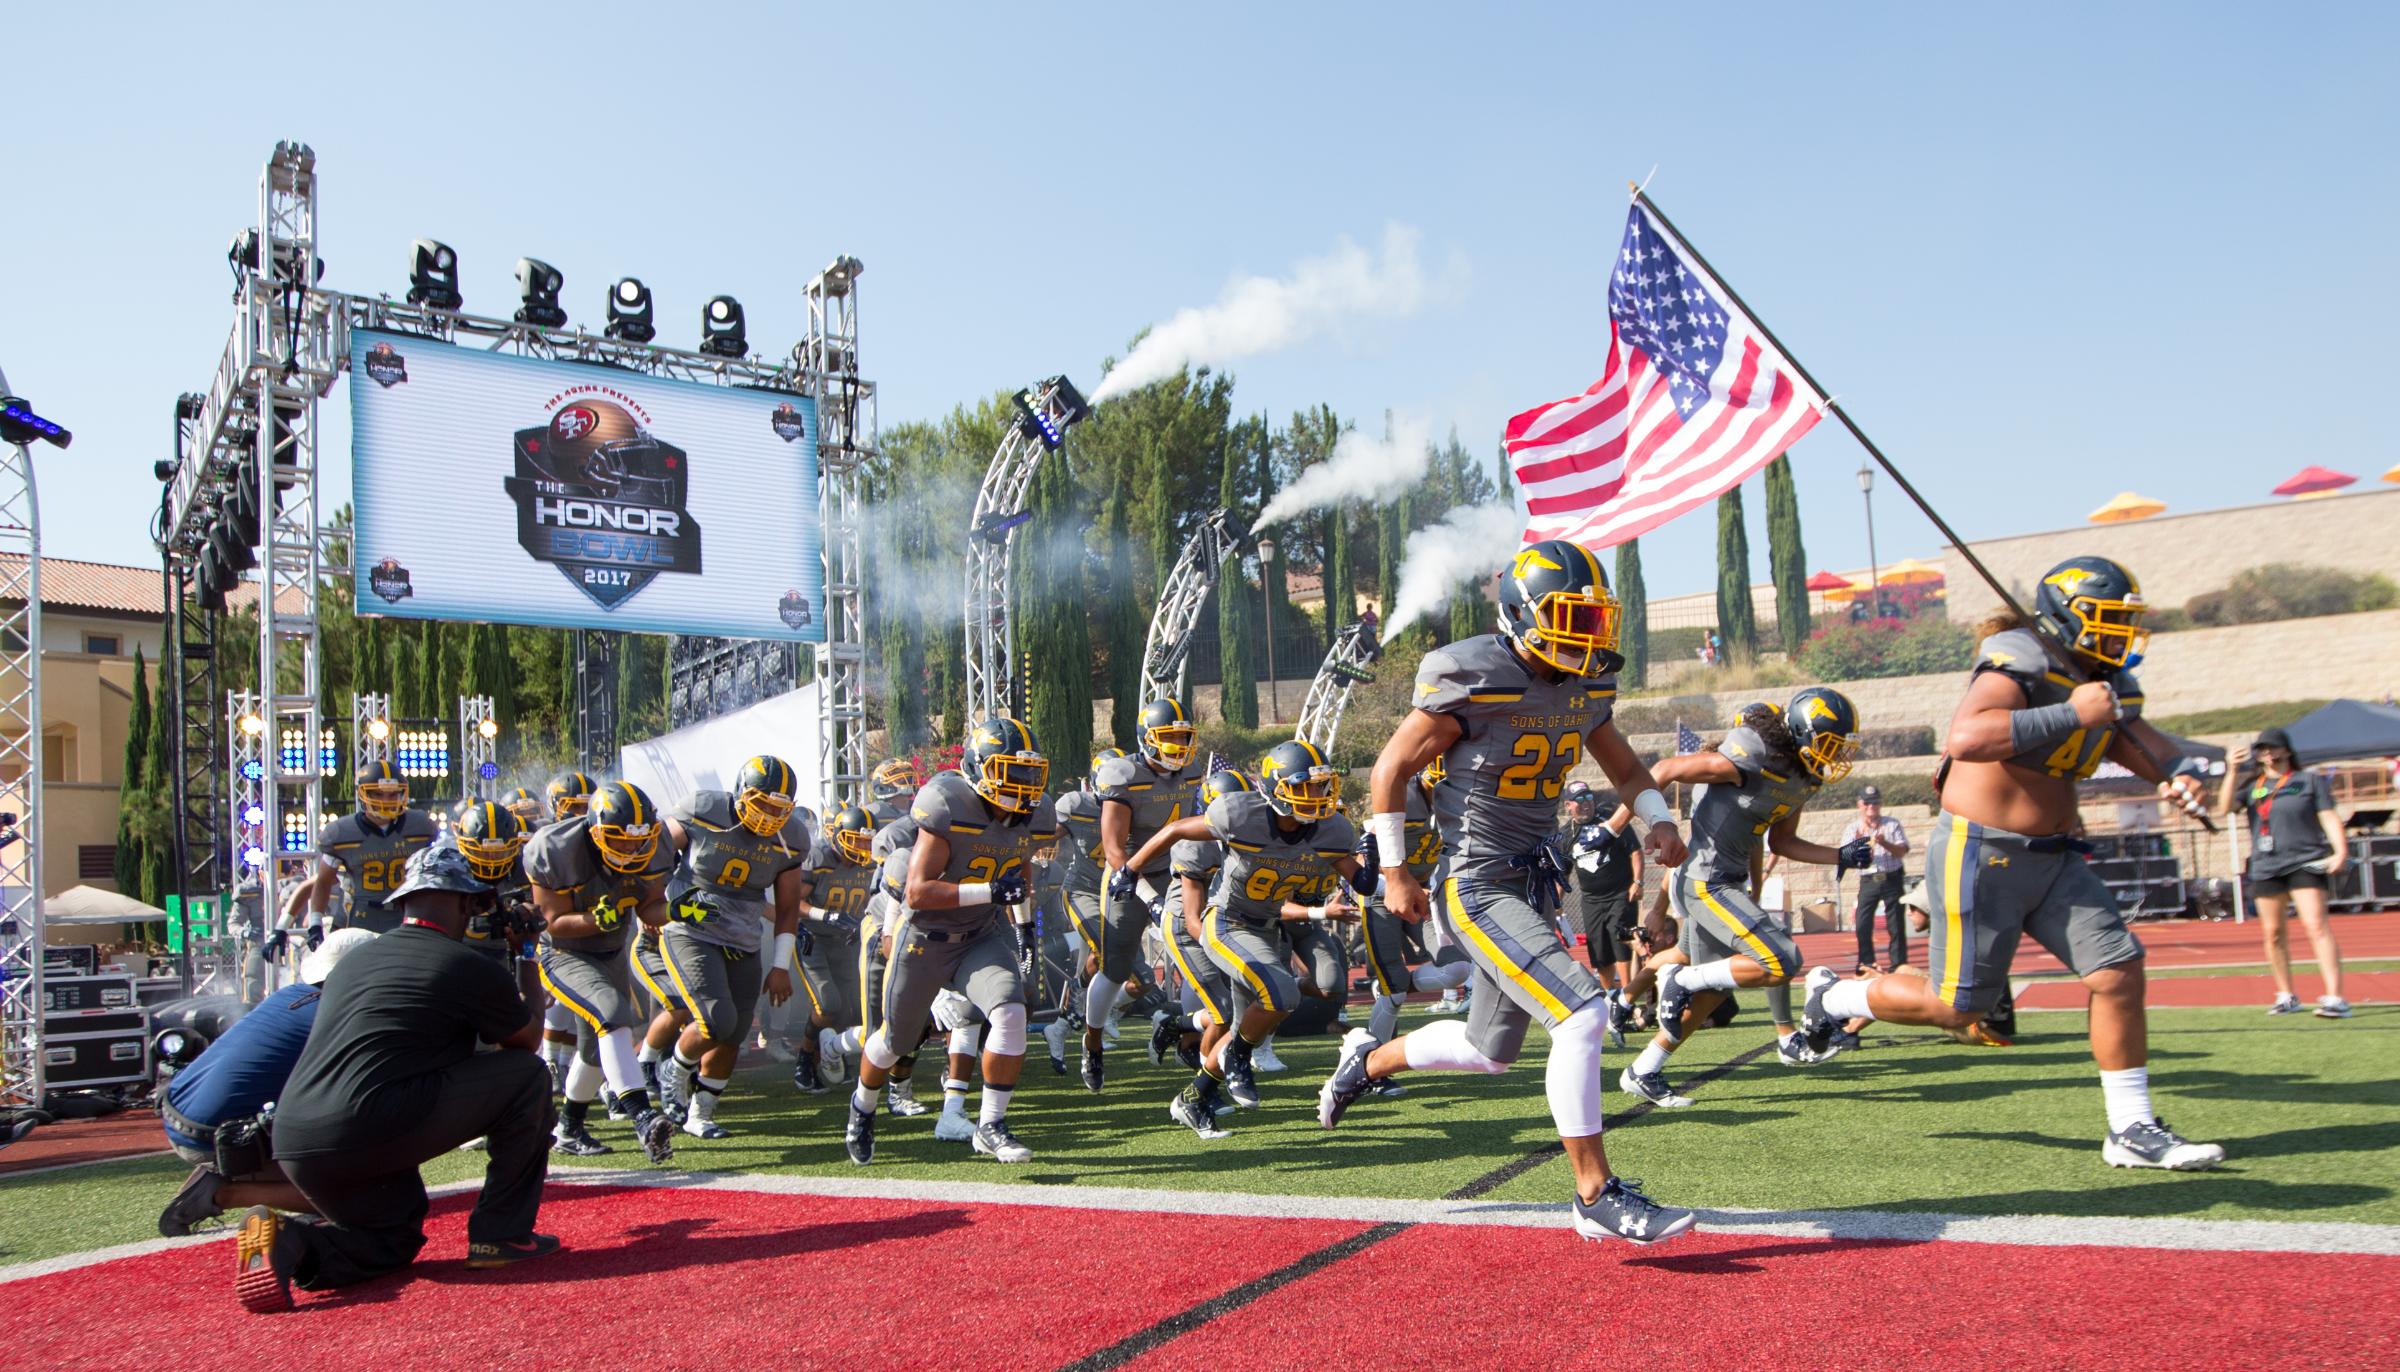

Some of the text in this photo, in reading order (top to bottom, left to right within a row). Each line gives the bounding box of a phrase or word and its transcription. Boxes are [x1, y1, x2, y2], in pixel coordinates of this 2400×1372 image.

[544, 393, 563, 412] THE
[602, 386, 653, 425] PRESENTS
[534, 480, 566, 494] THE
[535, 496, 681, 538] HONOR
[551, 528, 675, 565] BOWL
[584, 568, 632, 586] 2017
[1510, 715, 1544, 729] SONS
[1548, 715, 1562, 728] OF
[1495, 730, 1582, 800] 23
[973, 844, 996, 855] SONS
[1279, 859, 1290, 869] OF
[361, 857, 407, 892] 20
[1245, 865, 1309, 902] 82
